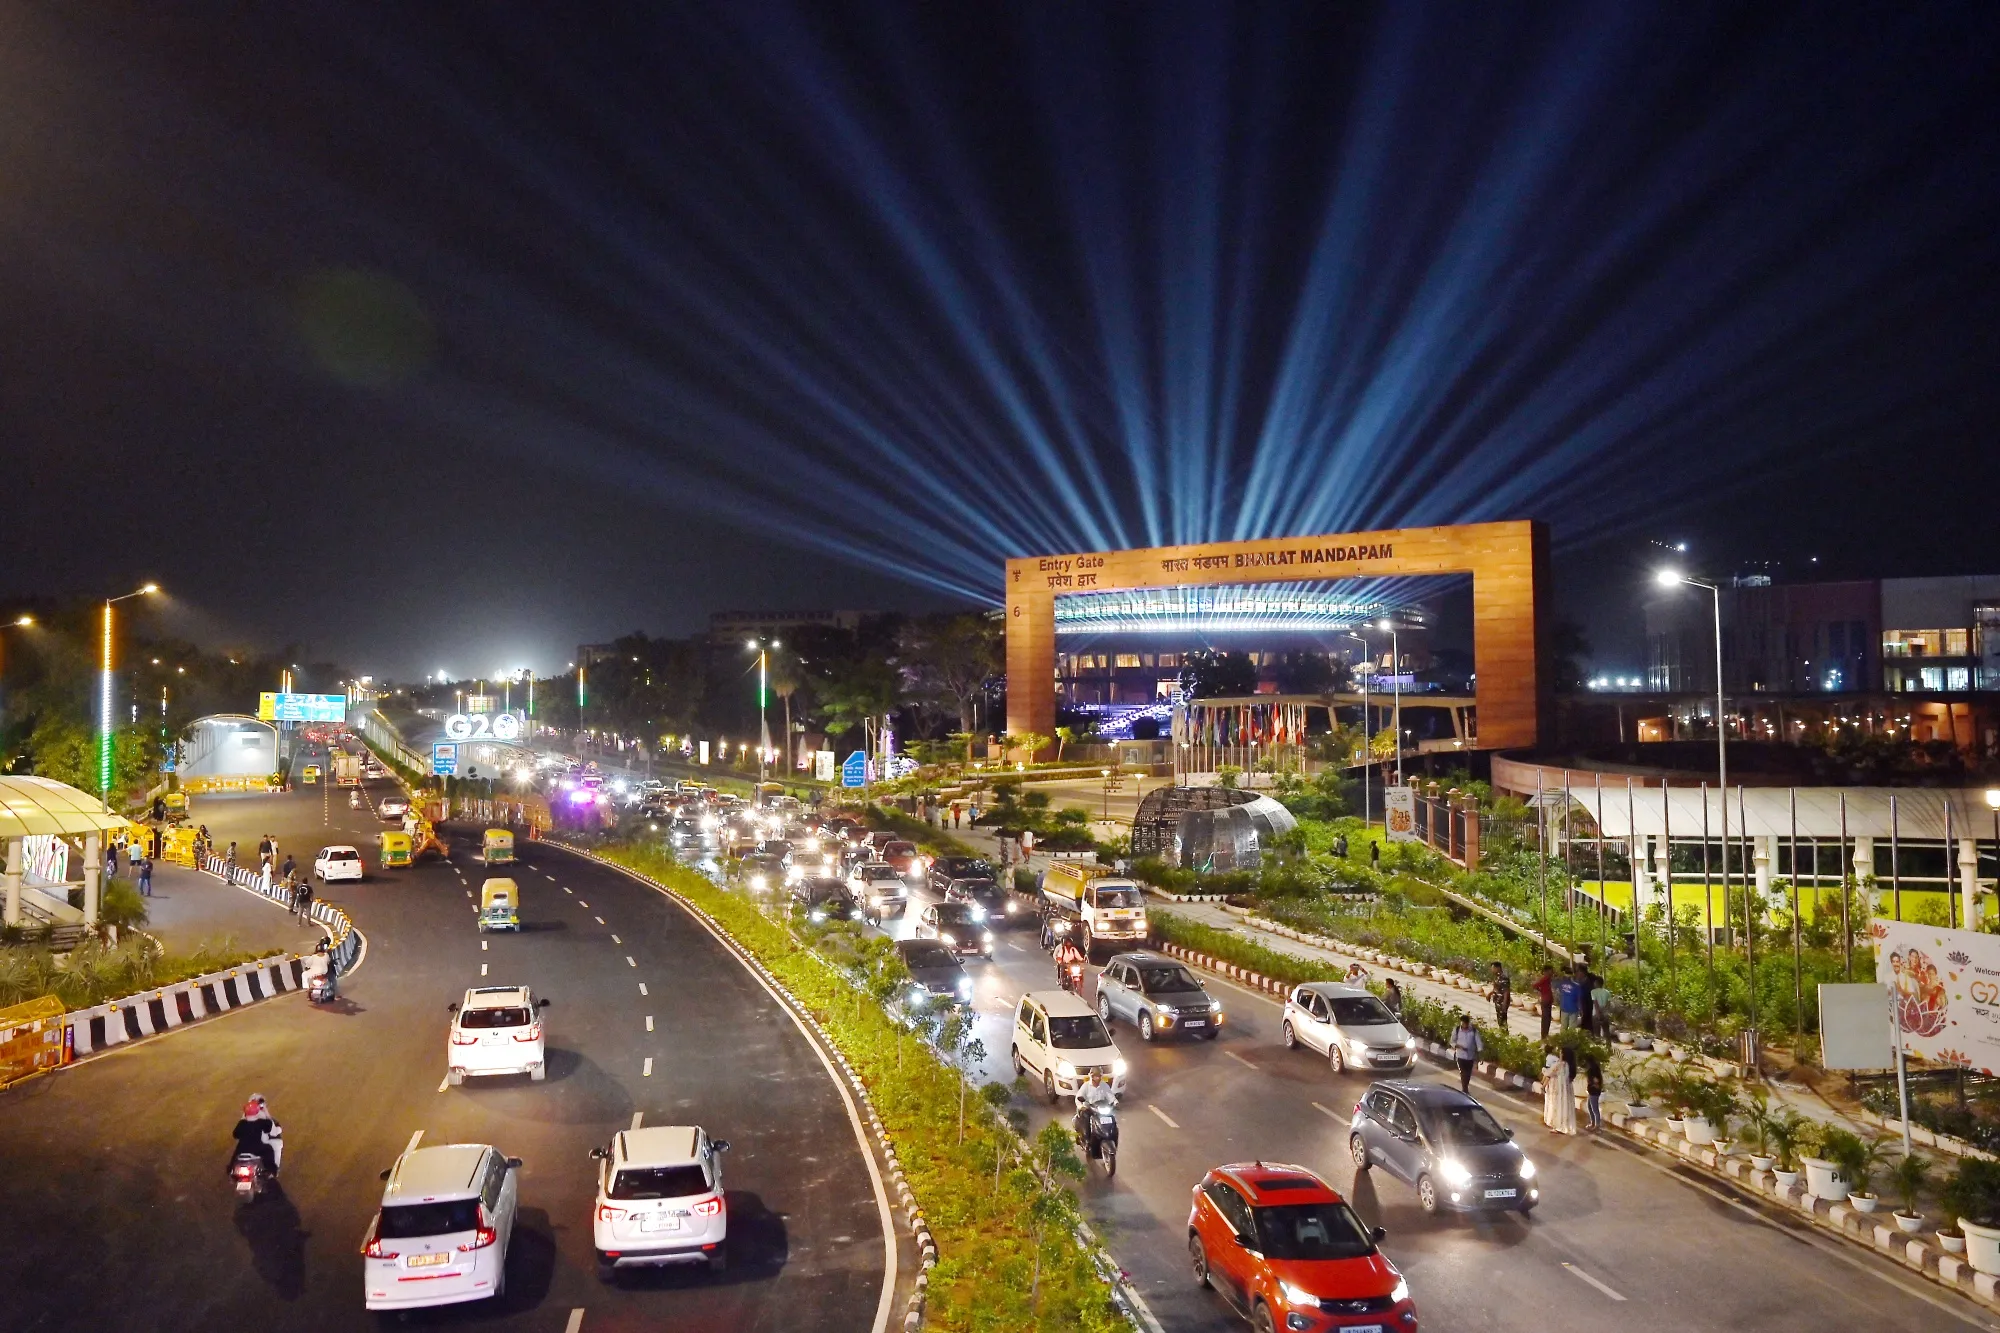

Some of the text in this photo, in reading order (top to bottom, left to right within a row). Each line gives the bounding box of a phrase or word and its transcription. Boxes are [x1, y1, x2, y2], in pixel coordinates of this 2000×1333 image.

[1040, 555, 1104, 572] Entry Gate
[1161, 558, 1189, 572] भारत
[1235, 550, 1296, 567] BHARAT
[1301, 544, 1392, 563] MANDAPAM
[1047, 572, 1097, 589] प्रवेश द्वार
[1013, 606, 1021, 617] 6
